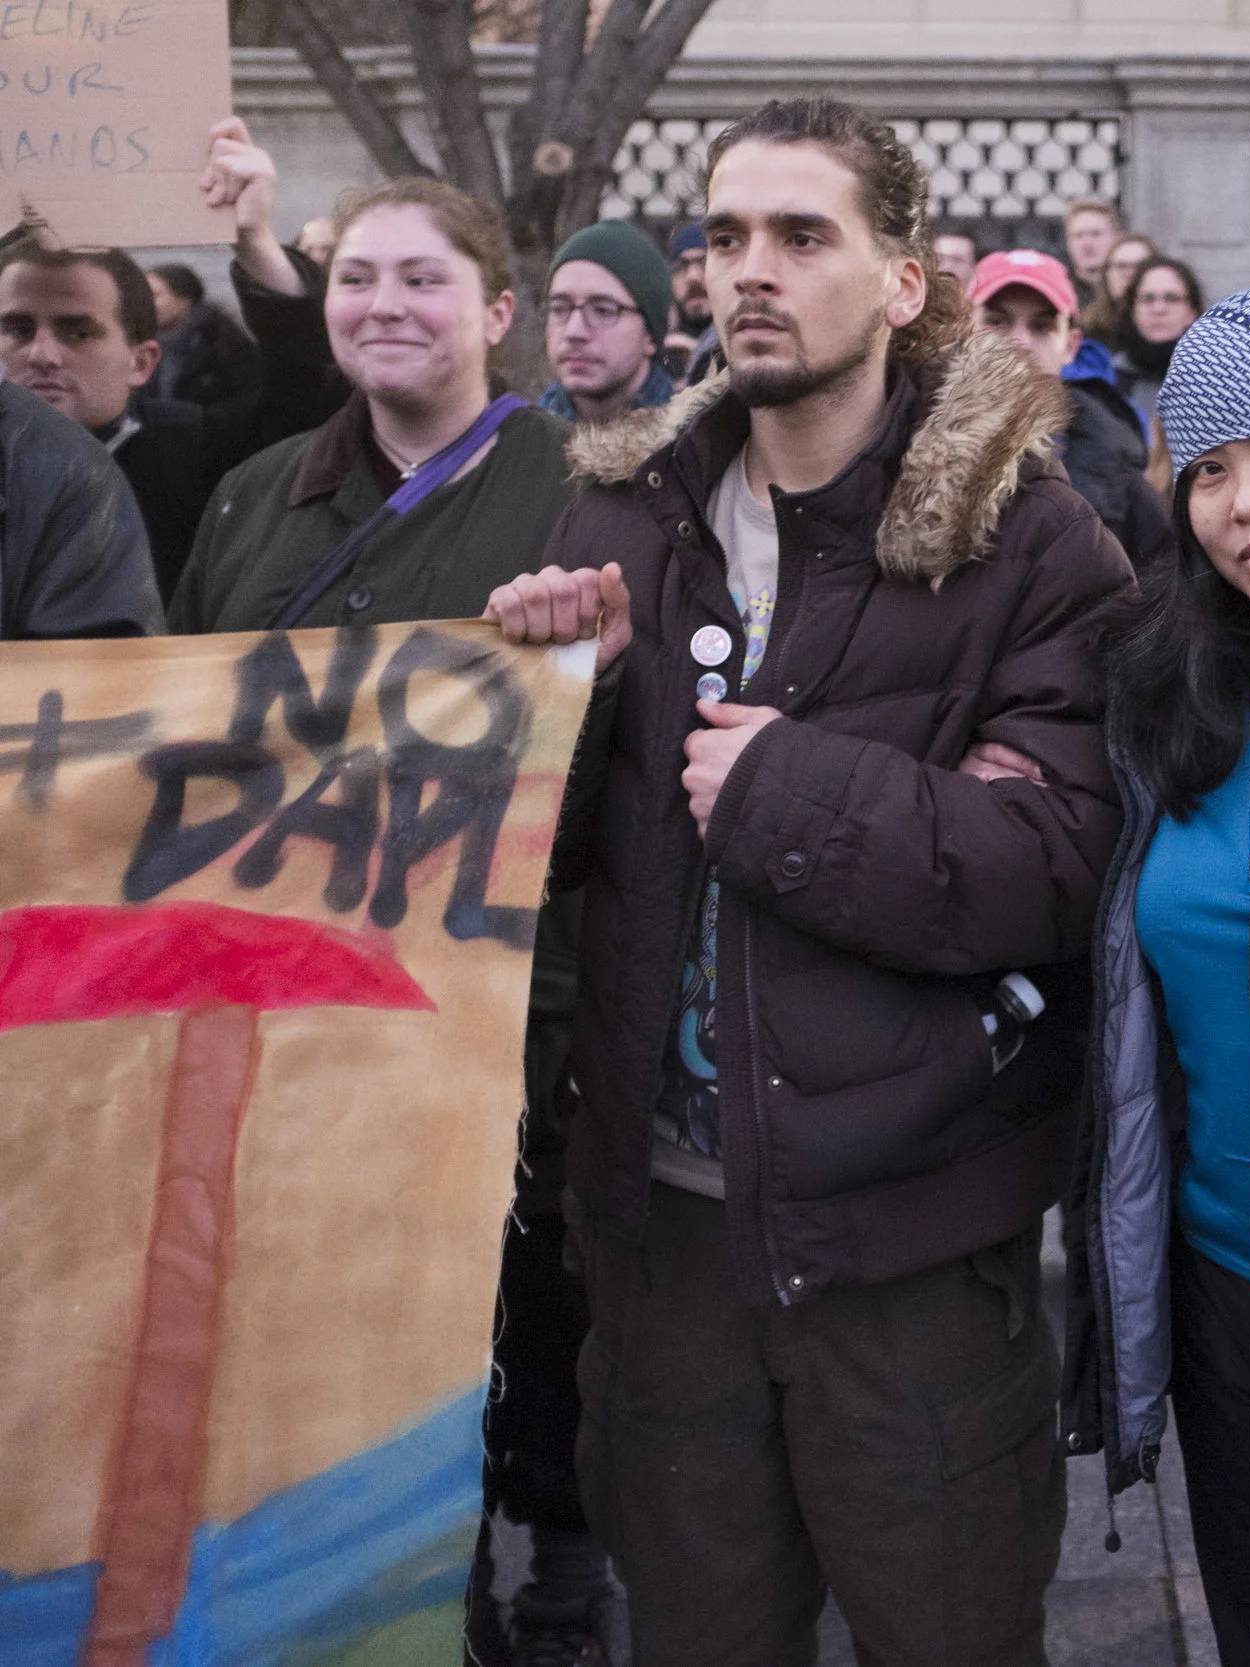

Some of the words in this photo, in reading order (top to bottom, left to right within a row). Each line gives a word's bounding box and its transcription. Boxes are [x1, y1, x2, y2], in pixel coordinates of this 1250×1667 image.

[0, 124, 150, 176] ANOS
[228, 623, 534, 758] NO
[122, 740, 541, 951] DAPL
